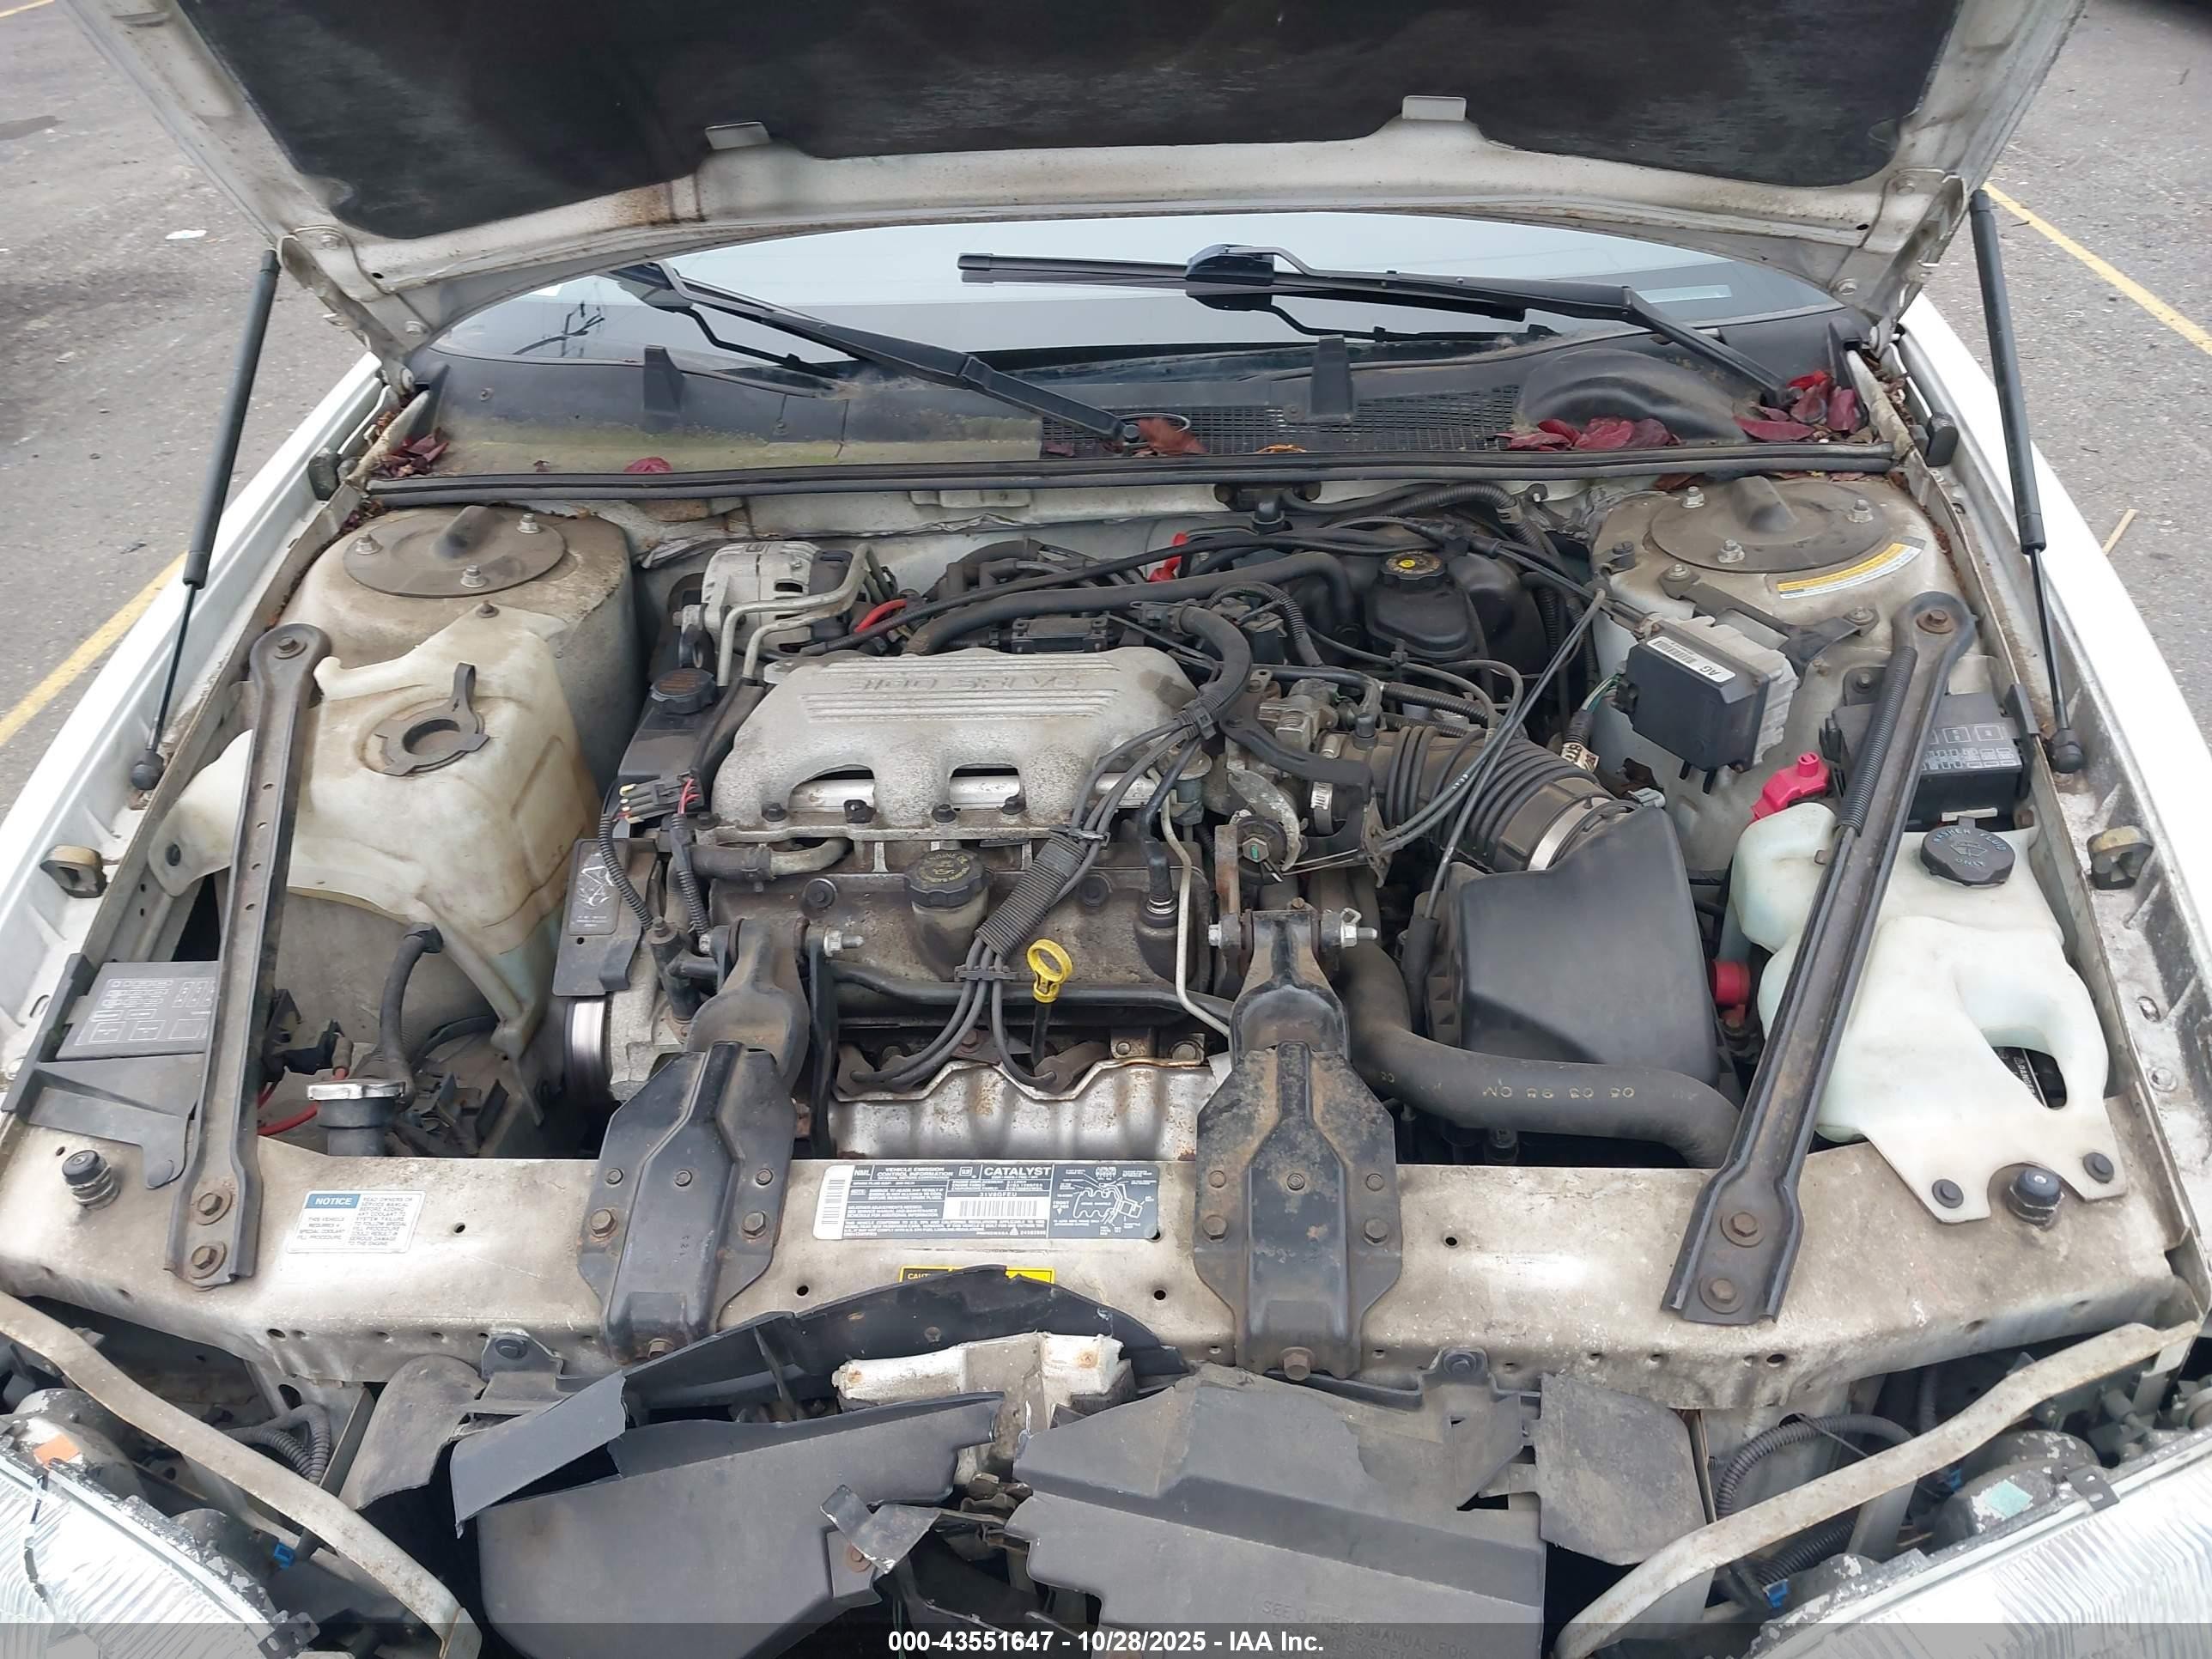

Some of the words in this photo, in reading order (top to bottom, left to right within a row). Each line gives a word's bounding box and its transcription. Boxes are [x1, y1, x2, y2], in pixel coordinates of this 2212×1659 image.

[1933, 829, 1972, 843] WASHER
[1979, 832, 2007, 852] FLUID
[1955, 858, 1986, 867] ONLY
[984, 1167, 1051, 1176] CATALYST
[1261, 1600, 1291, 1620] SEE
